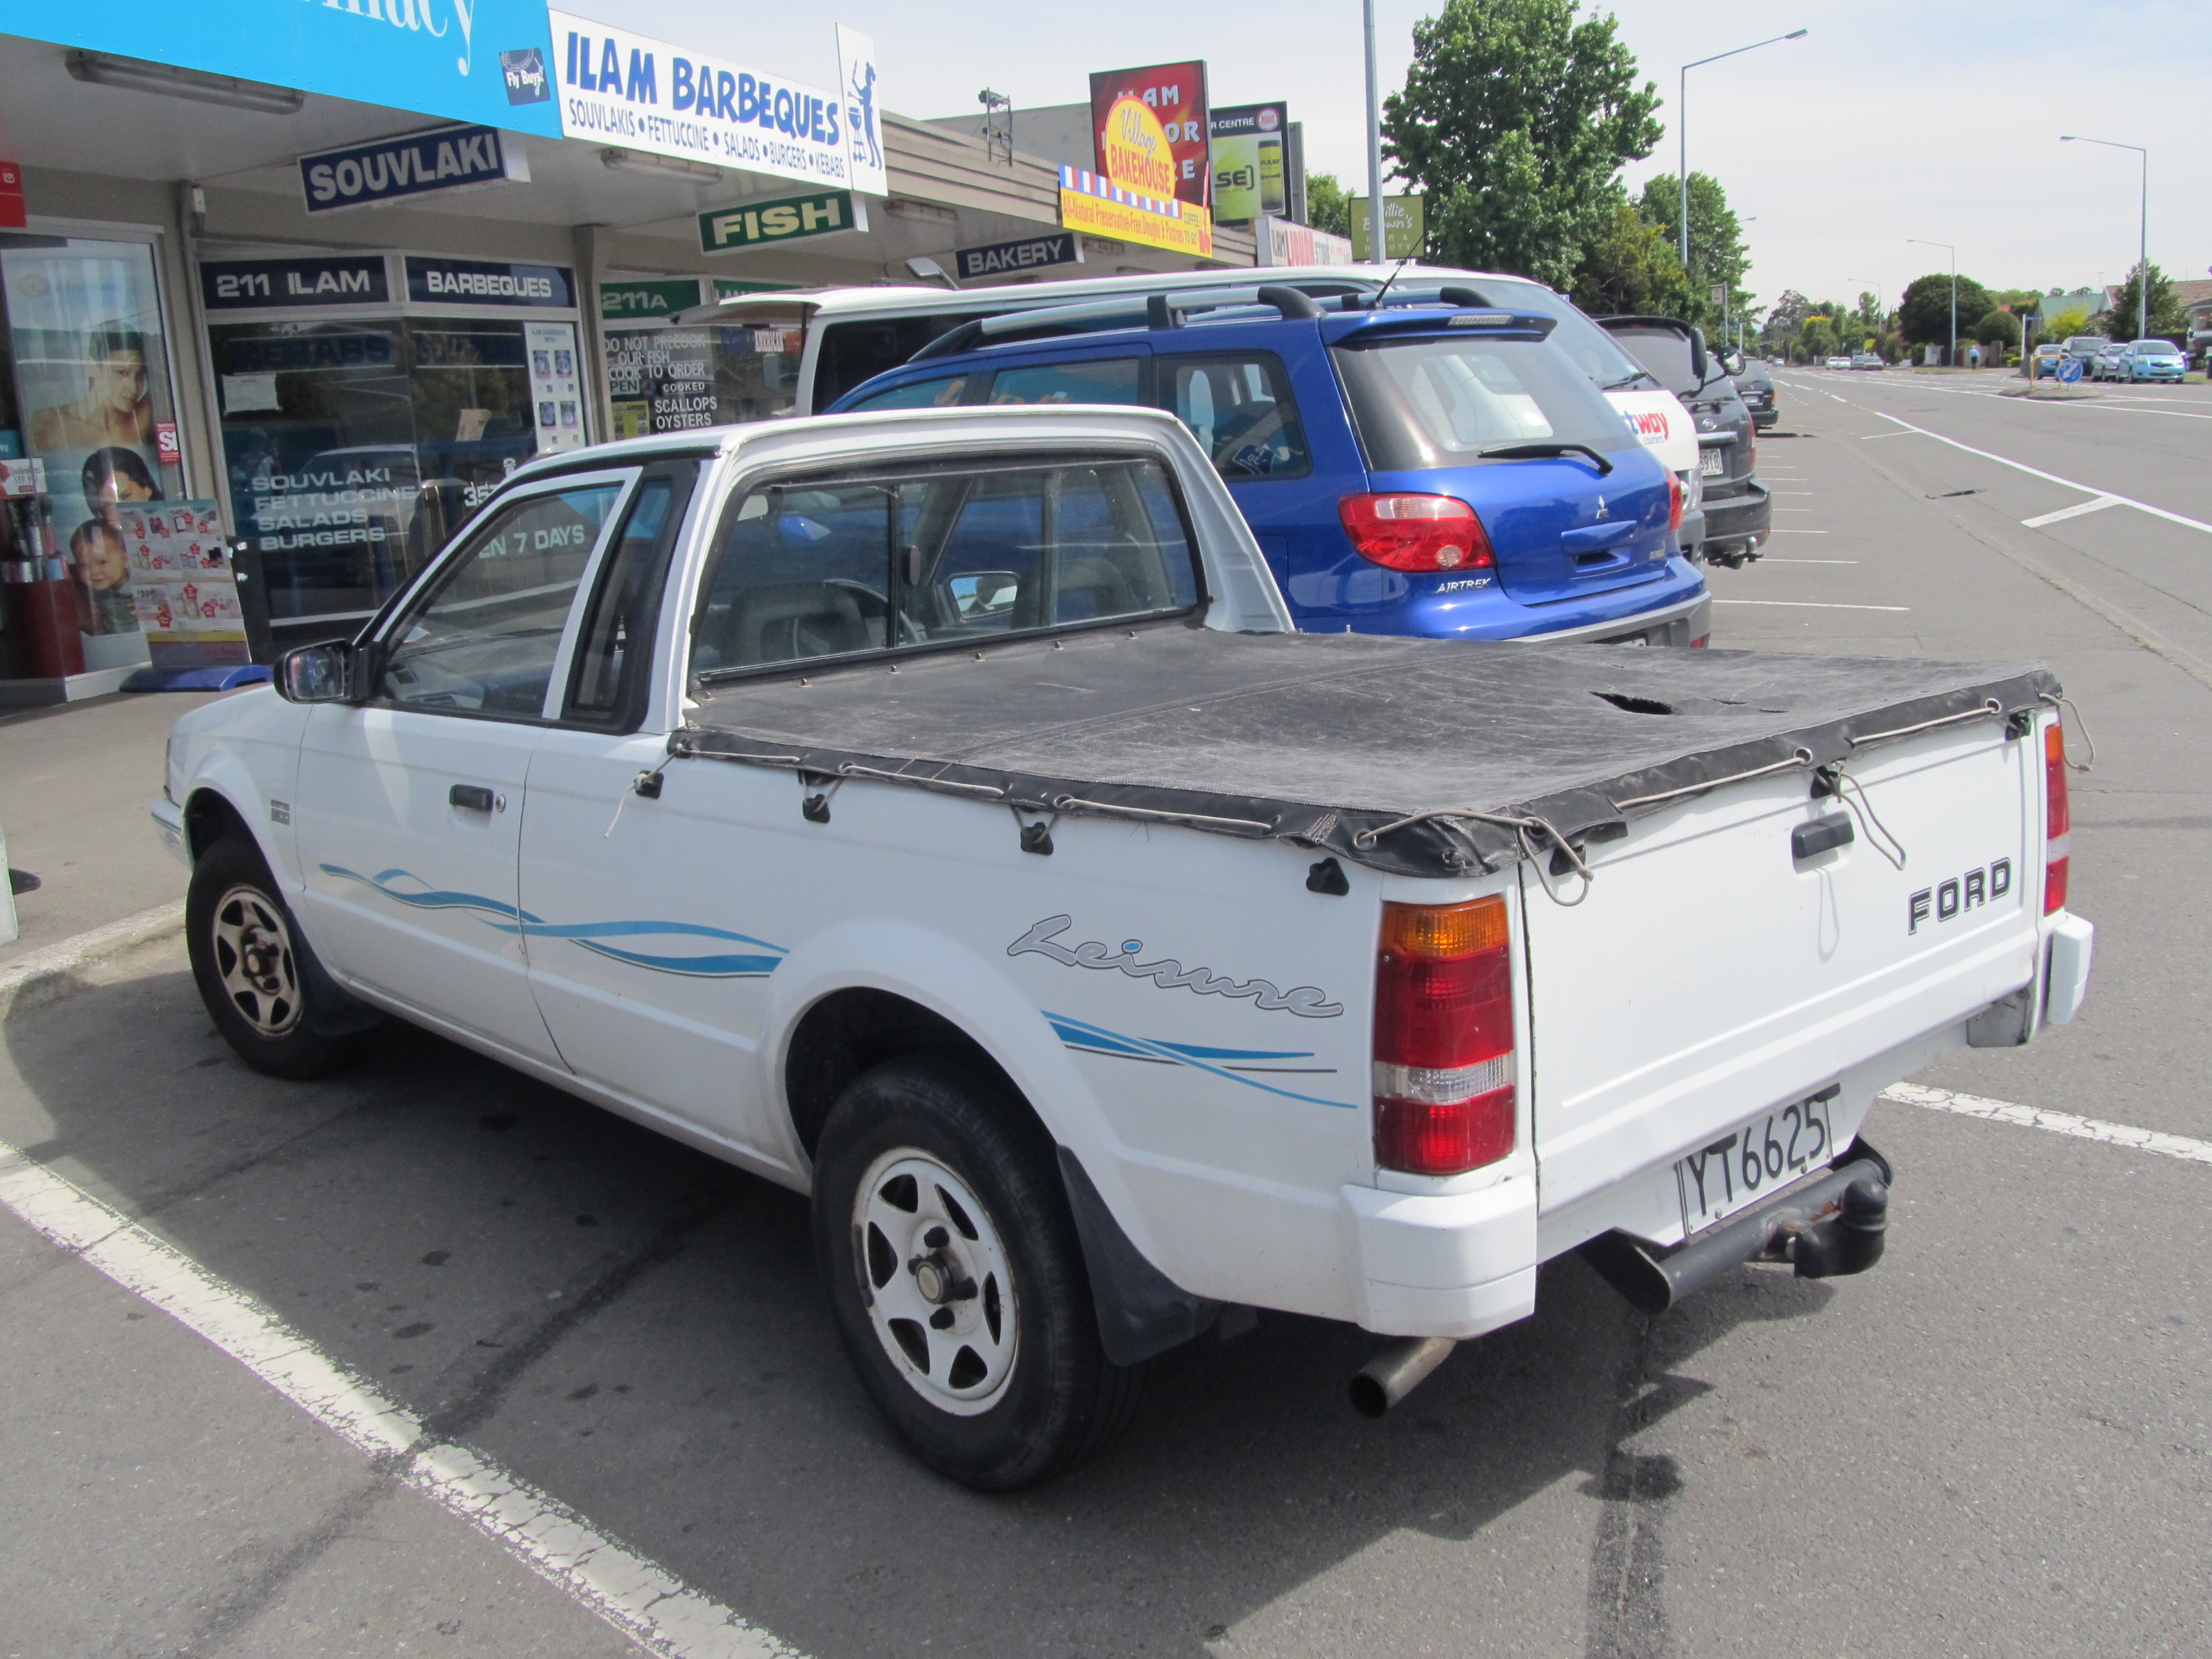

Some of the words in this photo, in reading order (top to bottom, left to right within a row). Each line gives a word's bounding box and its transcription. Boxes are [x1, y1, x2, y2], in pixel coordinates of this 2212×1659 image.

[506, 71, 519, 89] Fly
[566, 31, 657, 104] ILAM
[672, 57, 840, 145] BARBEQUES
[1219, 117, 1254, 129] CENTRE
[569, 98, 635, 137] SOUVLAKIS
[648, 115, 709, 152] FETTUCCINE
[725, 133, 760, 162] SALADS
[770, 145, 807, 170] BURGERS
[815, 151, 845, 178] KEBABS
[1120, 108, 1157, 163] Village
[309, 134, 498, 201] SOUVLAKI
[1111, 143, 1171, 195] BAKEHOUSE
[712, 199, 841, 244] FISH
[1184, 212, 1199, 228] COFFEE
[966, 239, 1064, 275] BAKERY
[217, 273, 270, 297] 211
[288, 270, 369, 295] ILAM
[427, 270, 551, 297] BARBEQUES
[602, 291, 668, 310] 211A
[625, 337, 648, 351] NOT
[654, 334, 706, 350] PRECOOK
[618, 351, 643, 366] OUR
[647, 350, 669, 364] FISH
[609, 366, 642, 379] COOK
[648, 365, 663, 379] TO
[668, 362, 705, 377] ORDER
[610, 381, 637, 392] PEN
[663, 382, 705, 392] COOKED
[654, 397, 717, 413] SCALLOPS
[657, 412, 712, 429] OYSTERS
[1643, 436, 1664, 445] couriers
[252, 468, 391, 491] SOUVLAKI
[255, 485, 416, 511] FETTUCCINE
[258, 509, 368, 531] SALADS
[260, 527, 386, 551] BURGERS
[514, 533, 527, 553] 7
[535, 524, 584, 549] DAYS
[1436, 578, 1491, 593] AIRTREK
[1909, 857, 2011, 935] FORD
[1007, 914, 1343, 1018] Leisure
[1686, 1100, 1825, 1215] YT6625
